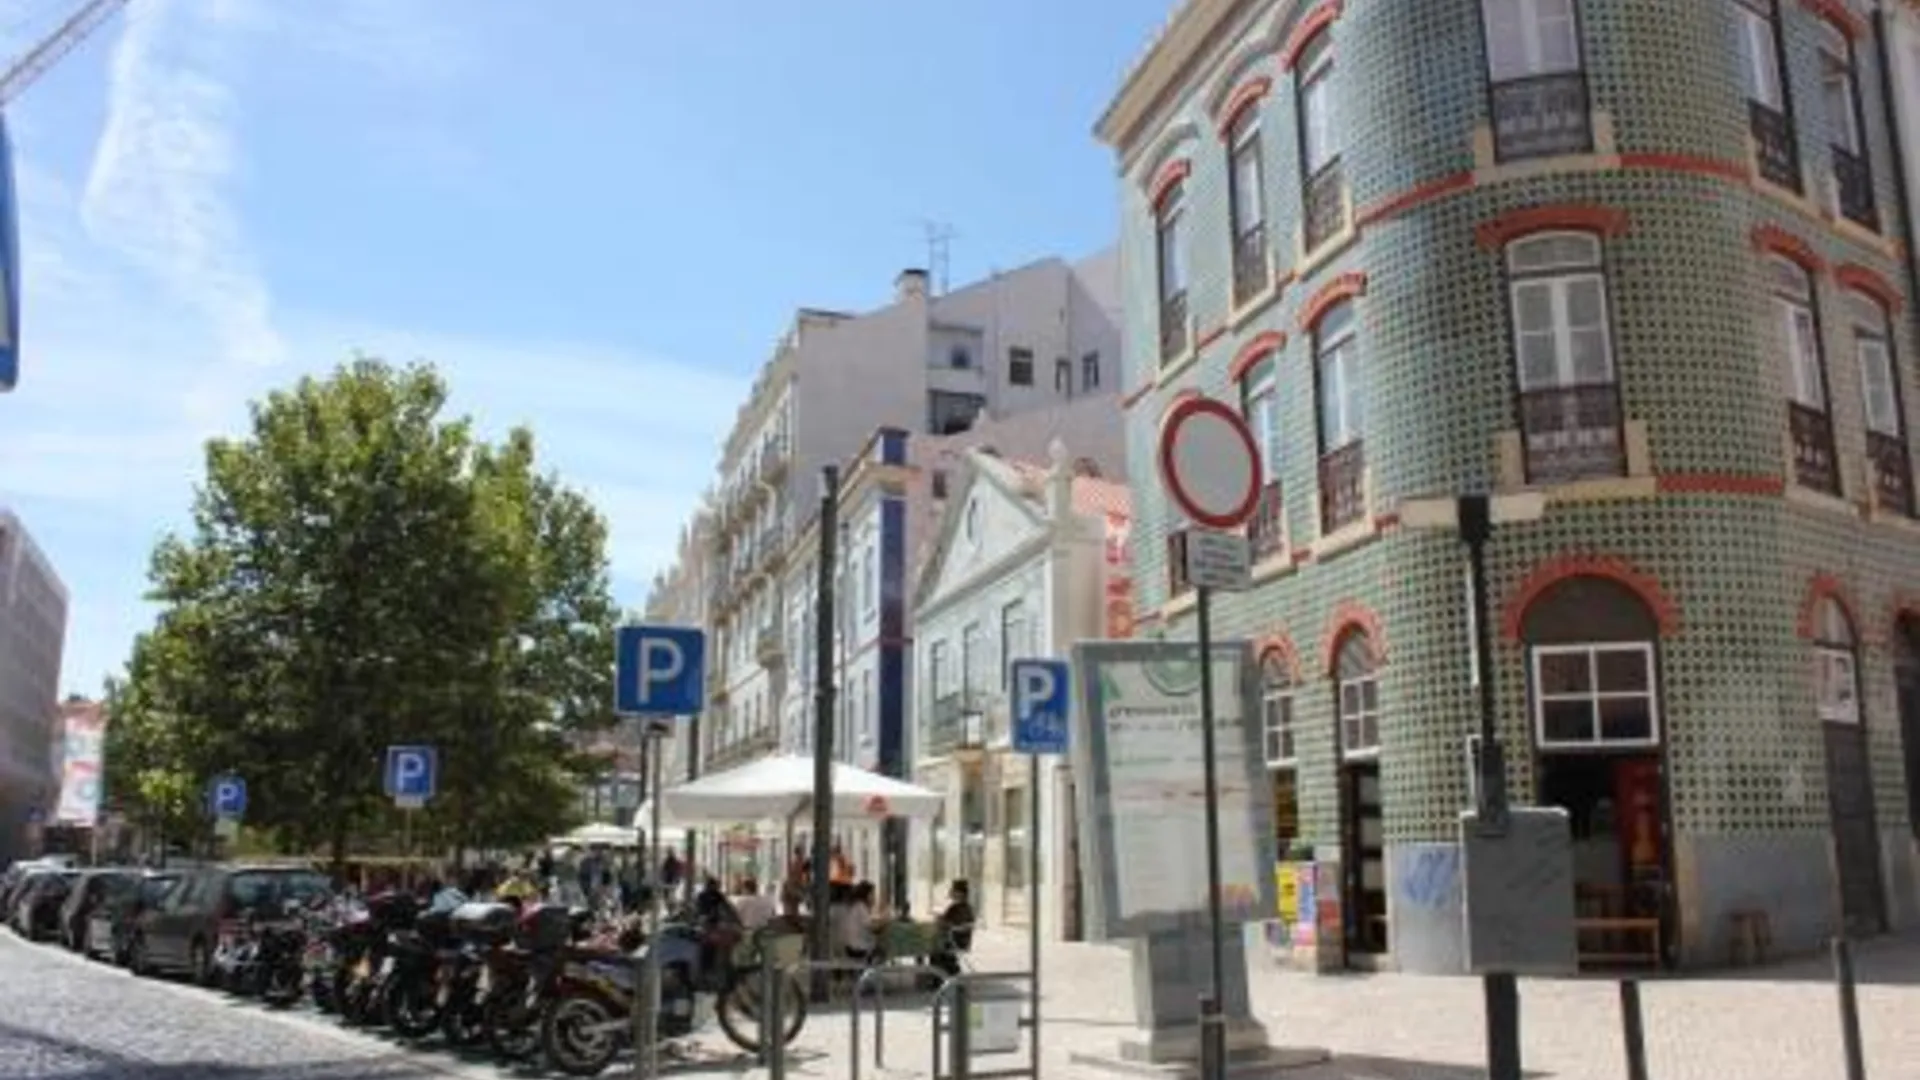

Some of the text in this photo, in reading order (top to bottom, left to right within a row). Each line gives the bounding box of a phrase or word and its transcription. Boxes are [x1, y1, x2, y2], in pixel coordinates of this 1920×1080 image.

[638, 637, 685, 704] P
[1018, 666, 1055, 719] P
[216, 783, 240, 806] P
[397, 752, 424, 792] P
